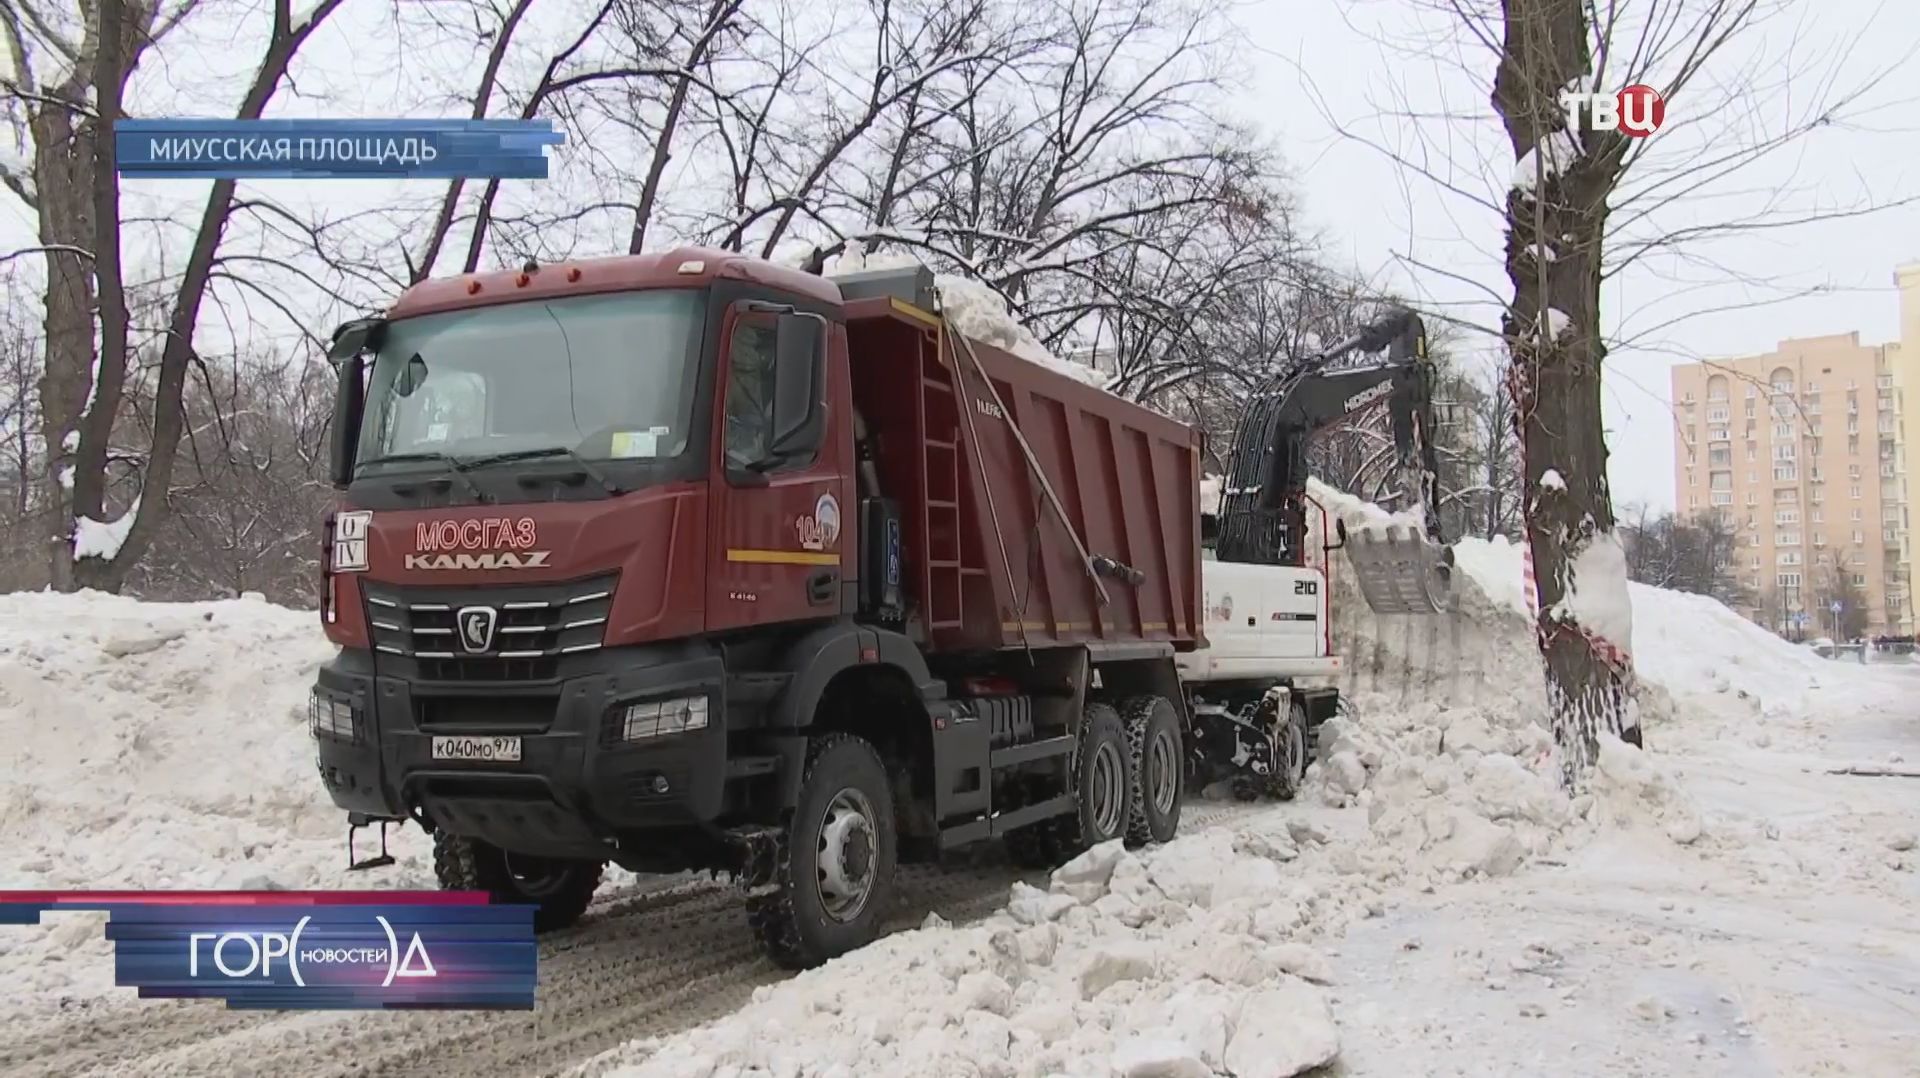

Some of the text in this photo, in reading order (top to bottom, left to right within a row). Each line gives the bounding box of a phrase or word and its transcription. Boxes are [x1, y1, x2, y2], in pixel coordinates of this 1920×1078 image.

[416, 517, 537, 551] МОСГАЗ
[404, 550, 552, 570] KAMAZ
[1293, 580, 1318, 595] 210
